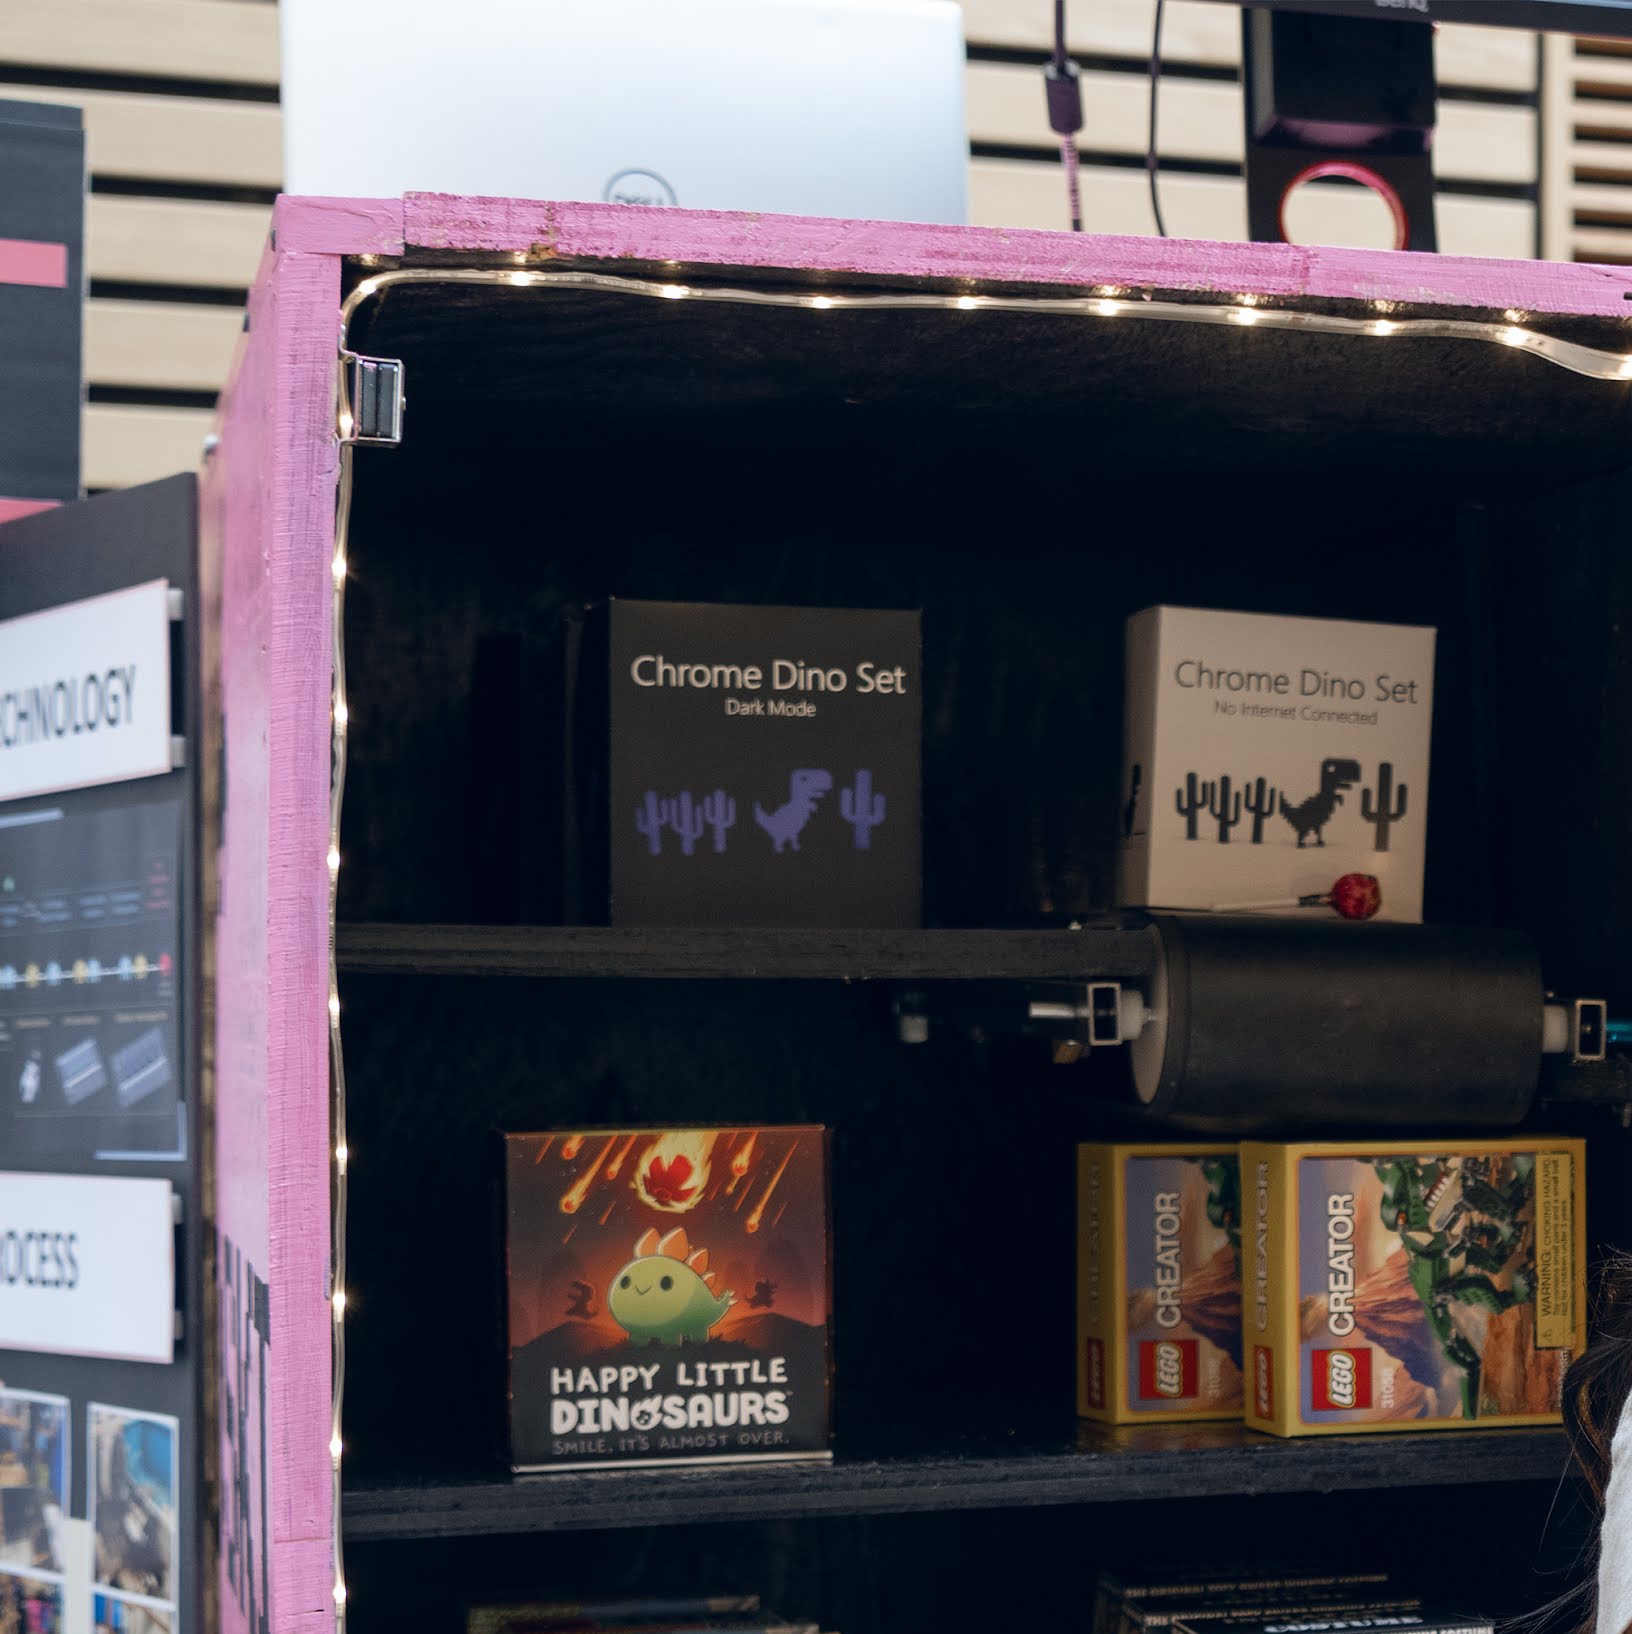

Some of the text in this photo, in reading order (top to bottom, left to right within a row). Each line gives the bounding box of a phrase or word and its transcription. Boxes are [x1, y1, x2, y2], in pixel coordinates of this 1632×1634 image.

[631, 654, 906, 694] Chrome Dino Set
[1174, 661, 1418, 704] Chrome Dino Set
[0, 664, 136, 749] CHNOLOGY
[725, 698, 816, 717] Dark Mode
[1215, 700, 1378, 725] No Internet Connected
[1543, 1201, 1551, 1246] CHOKING
[0, 1229, 79, 1290] OCESS
[1256, 1161, 1269, 1332] CREATOR
[1154, 1191, 1182, 1397] LEGO CREATOR
[1327, 1192, 1355, 1408] LEGO CREATOR
[1540, 1250, 1552, 1317] WARNING:
[551, 1357, 788, 1395] HAPPY LITTLE
[551, 1391, 790, 1435] DINOSAURS
[552, 1430, 789, 1456] SMILE, IT'S ALMOST OVER.
